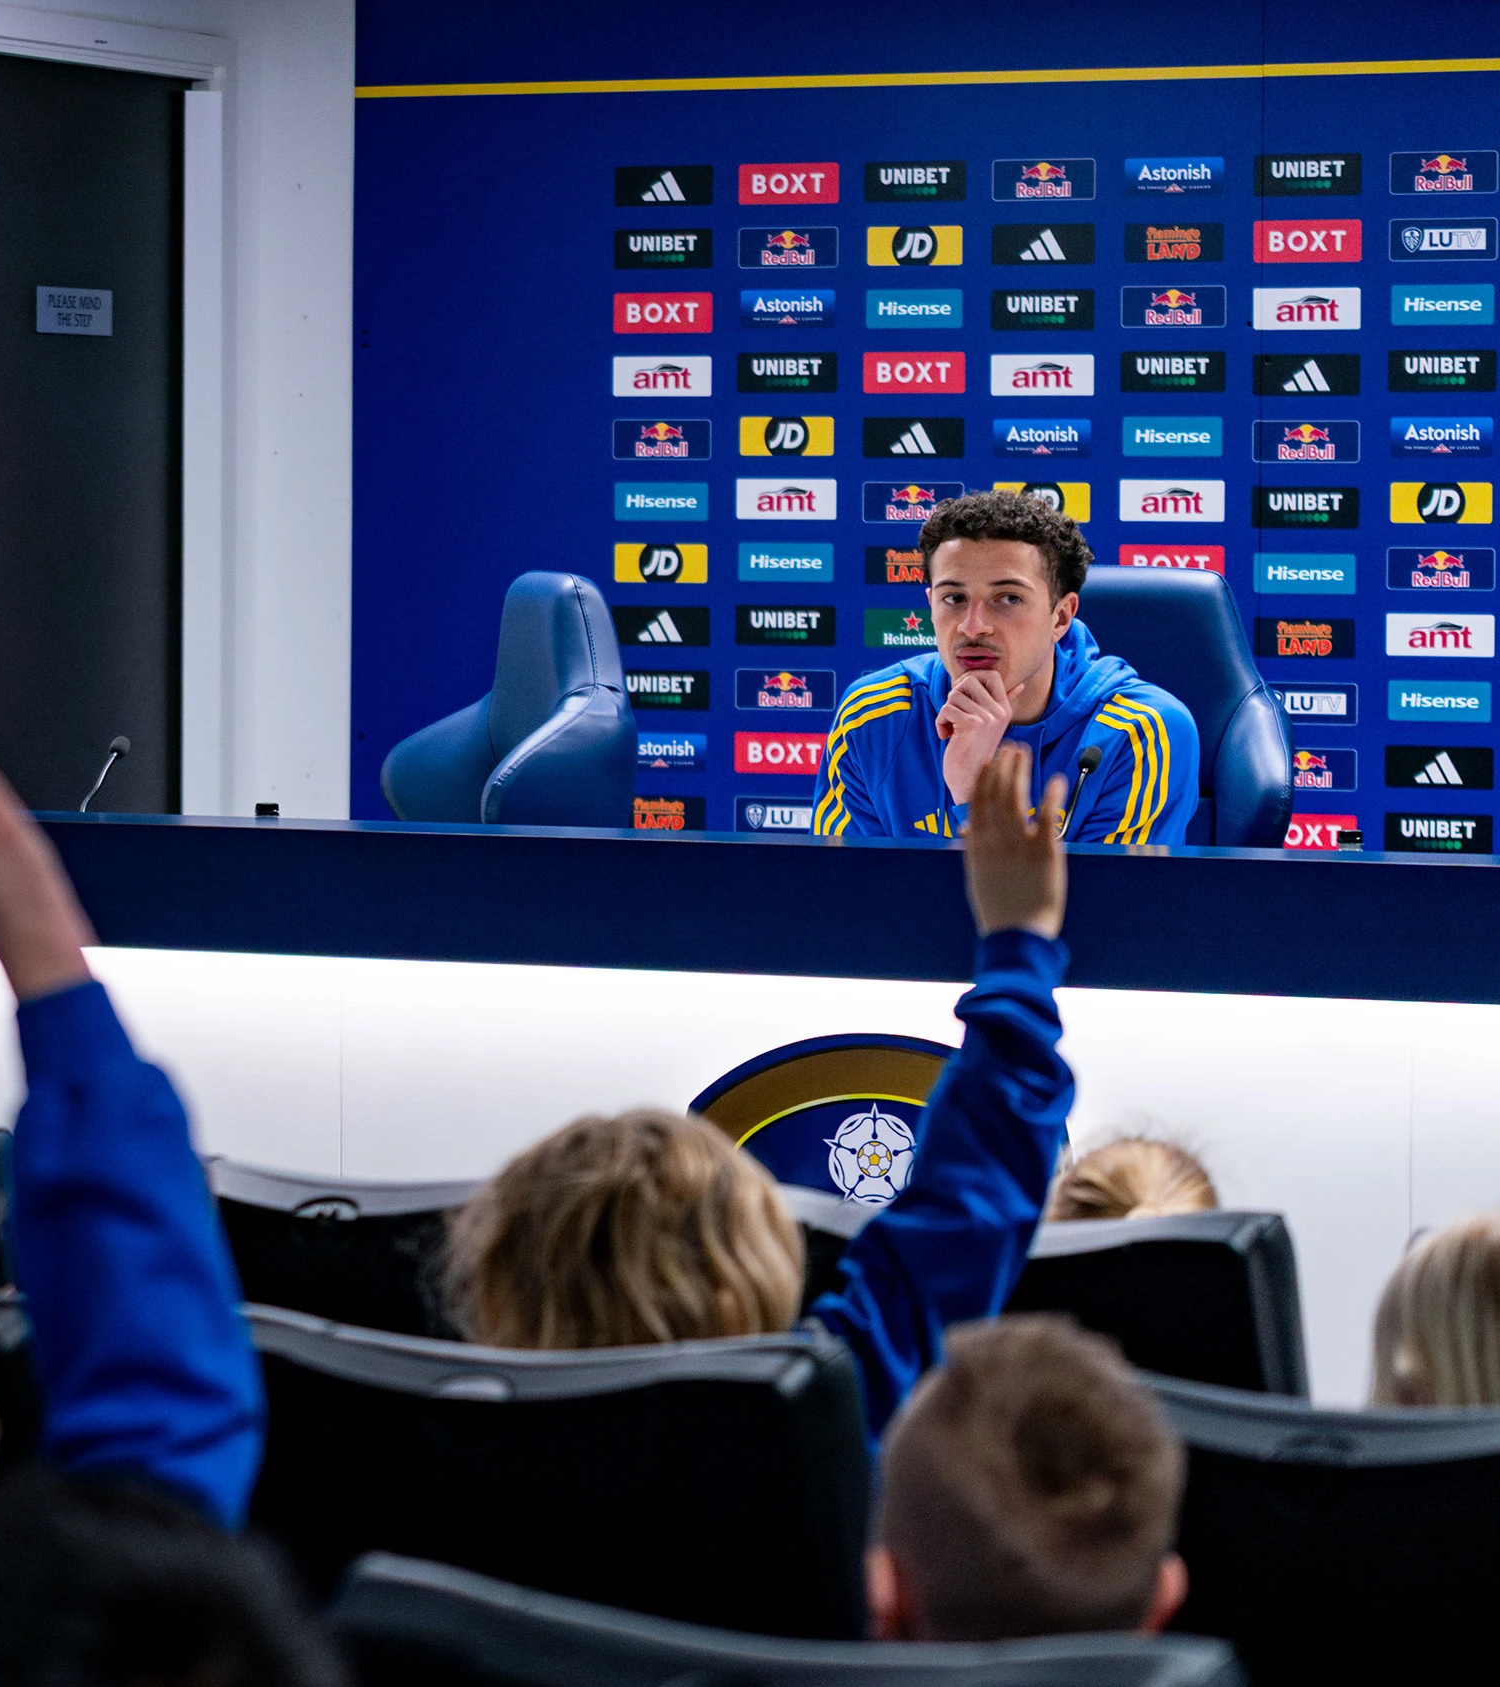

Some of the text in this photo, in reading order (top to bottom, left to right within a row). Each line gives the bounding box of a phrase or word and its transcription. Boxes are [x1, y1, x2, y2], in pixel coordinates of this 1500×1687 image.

[880, 168, 950, 185] UNIBET
[1138, 163, 1211, 182] Astonish
[1271, 160, 1345, 178] UNIBET
[752, 173, 825, 195] BOXT
[1016, 182, 1071, 198] Red Bull
[1415, 174, 1473, 192] Red Bull
[1146, 226, 1200, 242] flamingo
[1268, 229, 1347, 252] BOXT
[1429, 230, 1482, 248] LUTV
[629, 235, 697, 253] UNIBET
[897, 233, 933, 259] JD
[1146, 242, 1200, 260] LAND
[761, 250, 815, 266] Red Bull
[627, 303, 699, 324] BOXT
[753, 296, 823, 313] Astonish
[878, 302, 951, 316] Hisense
[1006, 296, 1079, 313] UNIBET
[1276, 300, 1339, 323] amt
[1404, 297, 1482, 312] Hisense
[1145, 309, 1201, 325] Red Bull
[752, 359, 822, 376] UNIBET
[876, 362, 950, 384] BOXT
[1136, 358, 1209, 375] UNIBET
[1404, 356, 1480, 375] UNIBET
[633, 367, 692, 390] amt
[1012, 365, 1073, 388] amt
[768, 422, 804, 449] JD
[1007, 426, 1078, 443] Astonish
[1134, 429, 1211, 445] Hisense
[1404, 424, 1480, 442] Astonish
[635, 442, 688, 458] Red Bull
[1278, 443, 1335, 461] Red Bull
[626, 494, 697, 509] Hisense
[757, 490, 816, 513] amt
[1033, 488, 1060, 511] D
[1141, 492, 1203, 515] amt
[1269, 493, 1343, 511] UNIBET
[1423, 489, 1460, 516] JD
[886, 505, 937, 521] Red Bul
[644, 550, 678, 576] JD
[750, 555, 822, 570] Hisense
[886, 549, 923, 565] flamin
[887, 565, 924, 583] LAN
[1267, 566, 1344, 581] Hisense
[1412, 571, 1469, 588] Red Bull
[751, 611, 820, 629] UNIBET
[1277, 621, 1332, 638] flamingo
[1408, 627, 1472, 649] amt
[1277, 638, 1332, 656] LAND
[627, 676, 694, 693] UNIBET
[758, 691, 812, 708] Red Bull
[1290, 695, 1342, 712] LUTV
[1401, 693, 1479, 709] Hisense
[638, 740, 694, 757] stonish
[748, 743, 821, 764] BOXT
[1305, 771, 1333, 788] Bull
[635, 813, 685, 831] LAND
[1401, 820, 1476, 839] UNIBET
[1286, 825, 1341, 847] OXT
